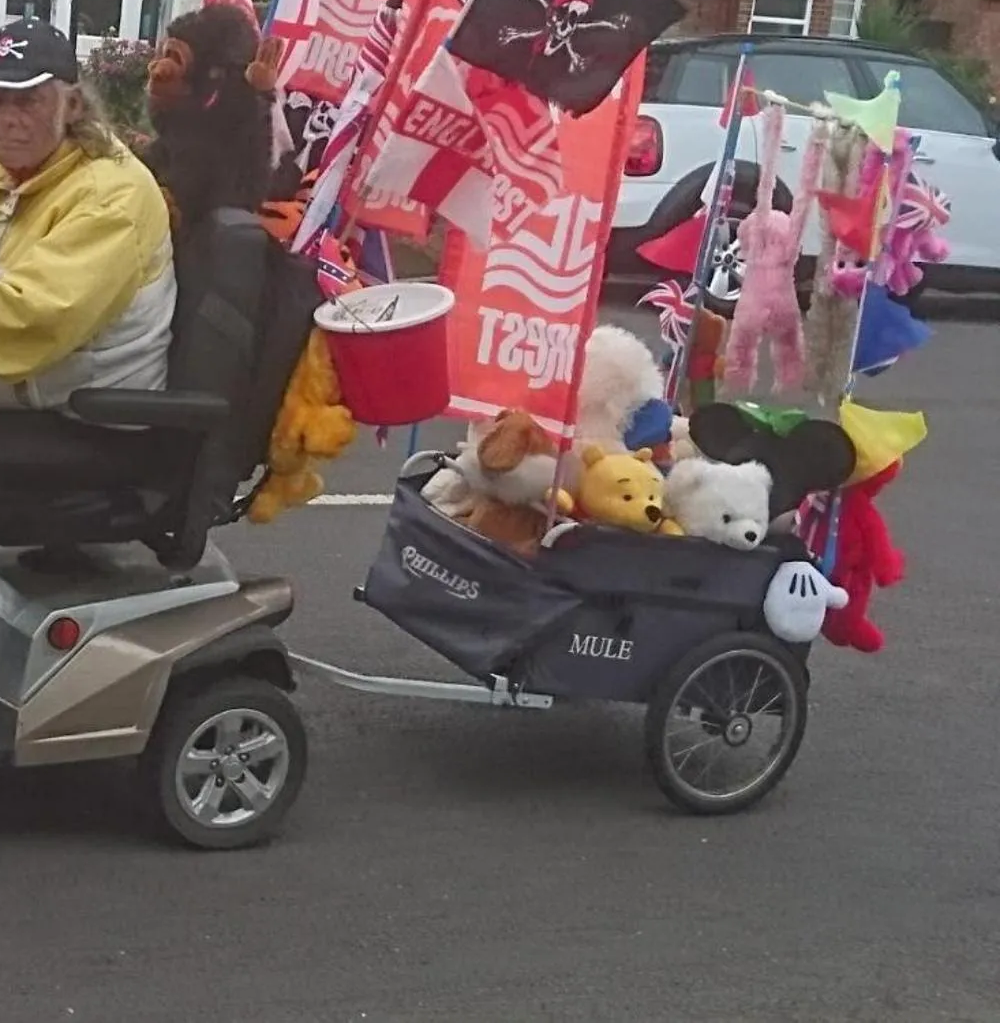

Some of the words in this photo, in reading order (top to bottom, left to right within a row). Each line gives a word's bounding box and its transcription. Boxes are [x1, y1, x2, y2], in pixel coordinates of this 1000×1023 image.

[403, 98, 494, 169] ENGLA
[402, 545, 481, 600] PHILLIPS
[568, 633, 634, 660] MULE
